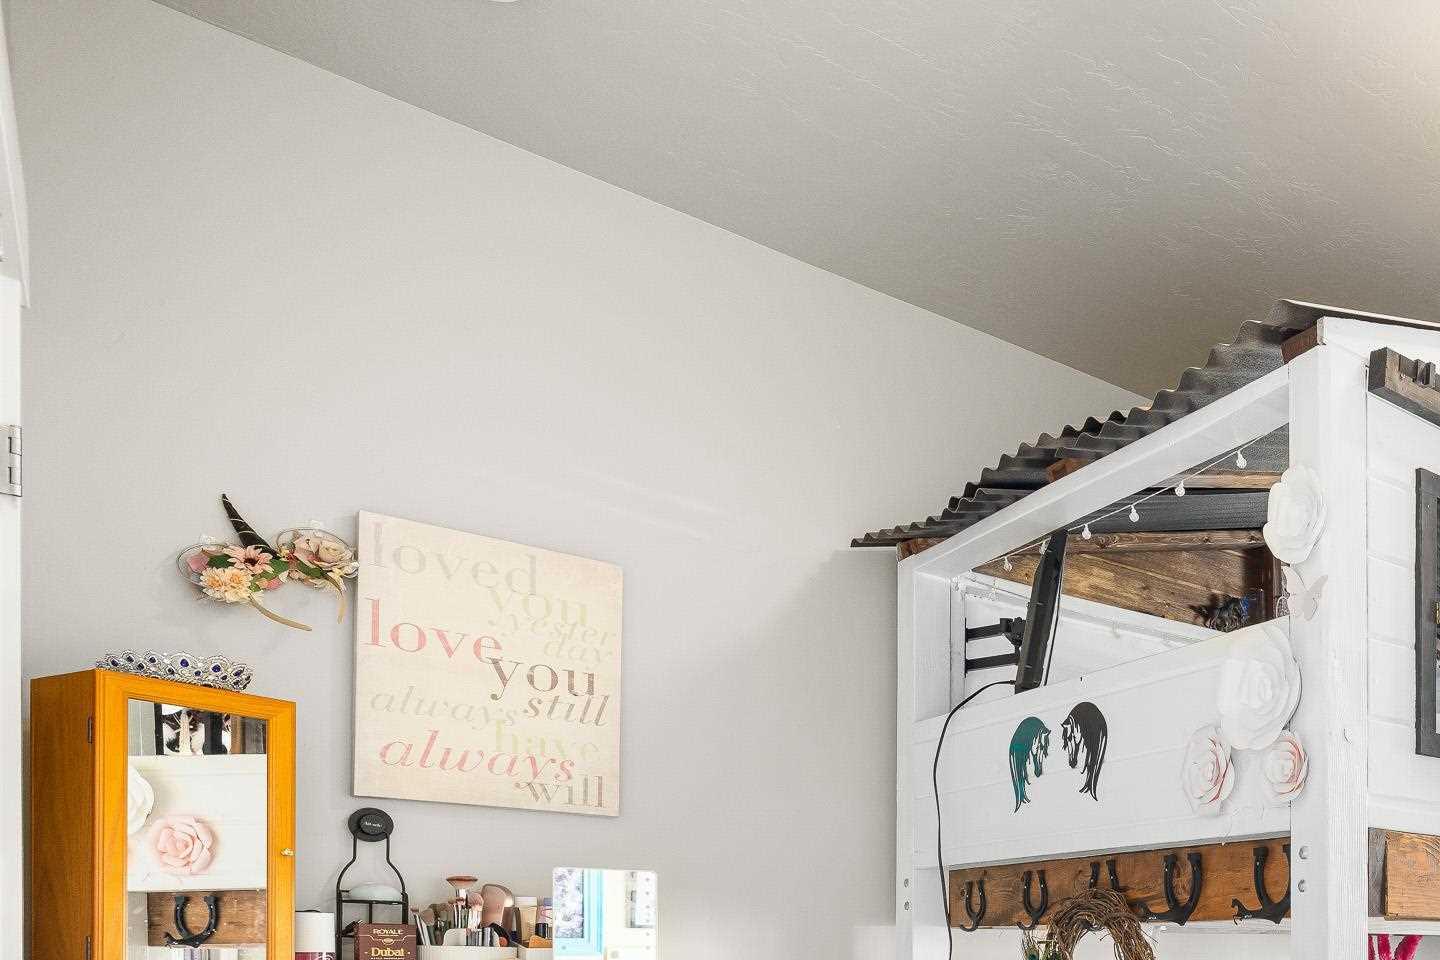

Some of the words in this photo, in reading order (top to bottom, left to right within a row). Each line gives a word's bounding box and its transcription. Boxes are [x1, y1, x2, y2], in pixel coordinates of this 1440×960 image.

[367, 522, 537, 596] loved
[487, 588, 588, 626] you
[361, 597, 502, 664] love
[486, 657, 595, 700] you
[370, 686, 518, 730] always
[523, 694, 610, 727] still
[379, 729, 575, 783] always
[514, 775, 606, 808] will
[371, 947, 405, 957] Dubai
